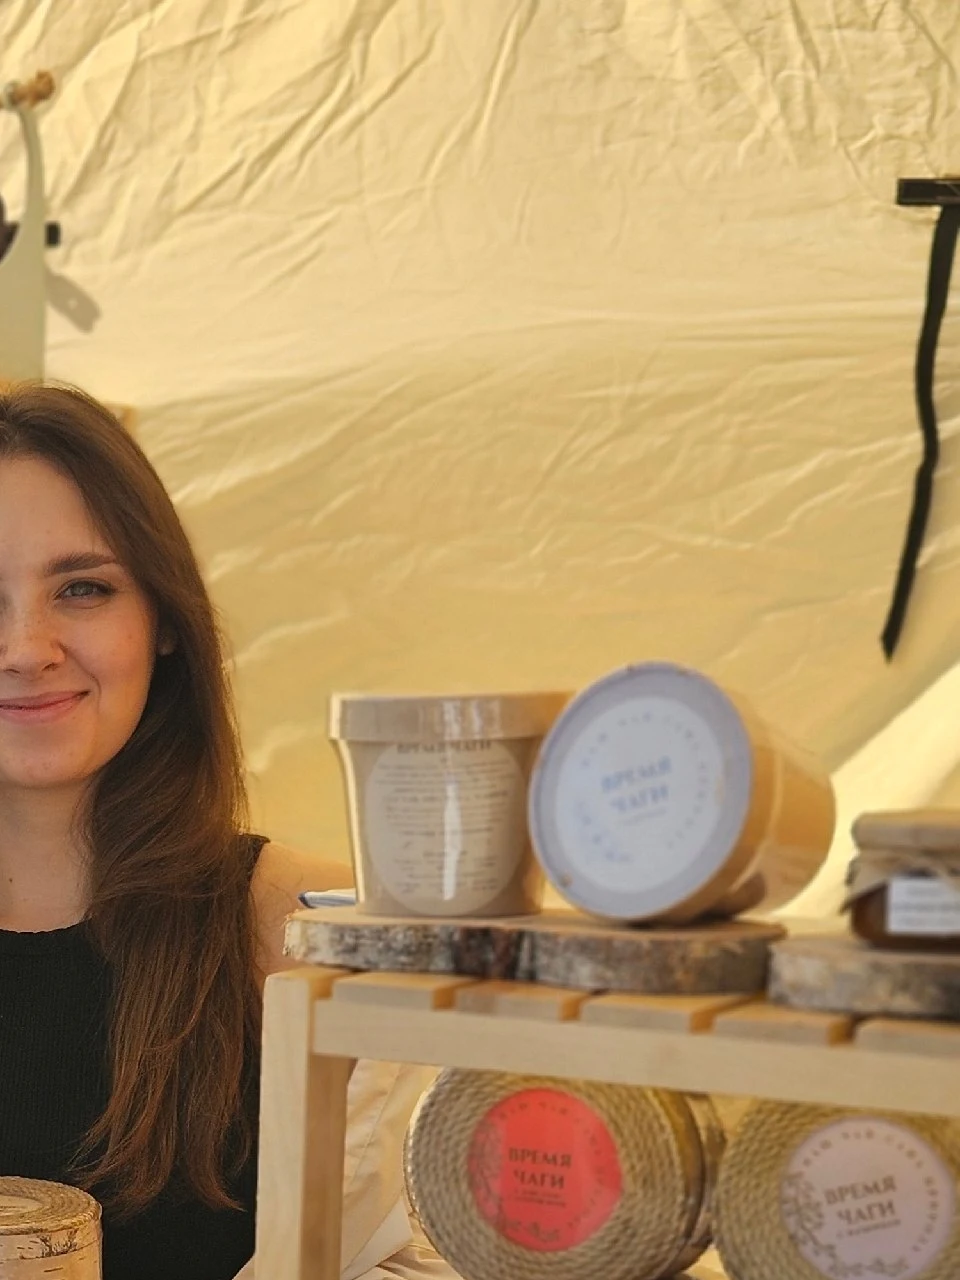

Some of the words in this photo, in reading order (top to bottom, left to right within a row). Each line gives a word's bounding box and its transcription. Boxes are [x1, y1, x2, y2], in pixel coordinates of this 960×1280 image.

[508, 1148, 572, 1170] ВРЕМЯ
[513, 1170, 565, 1190] ЧАГИ
[824, 1175, 898, 1206] ВРЕМЯ
[837, 1199, 896, 1226] ЧАГИ
